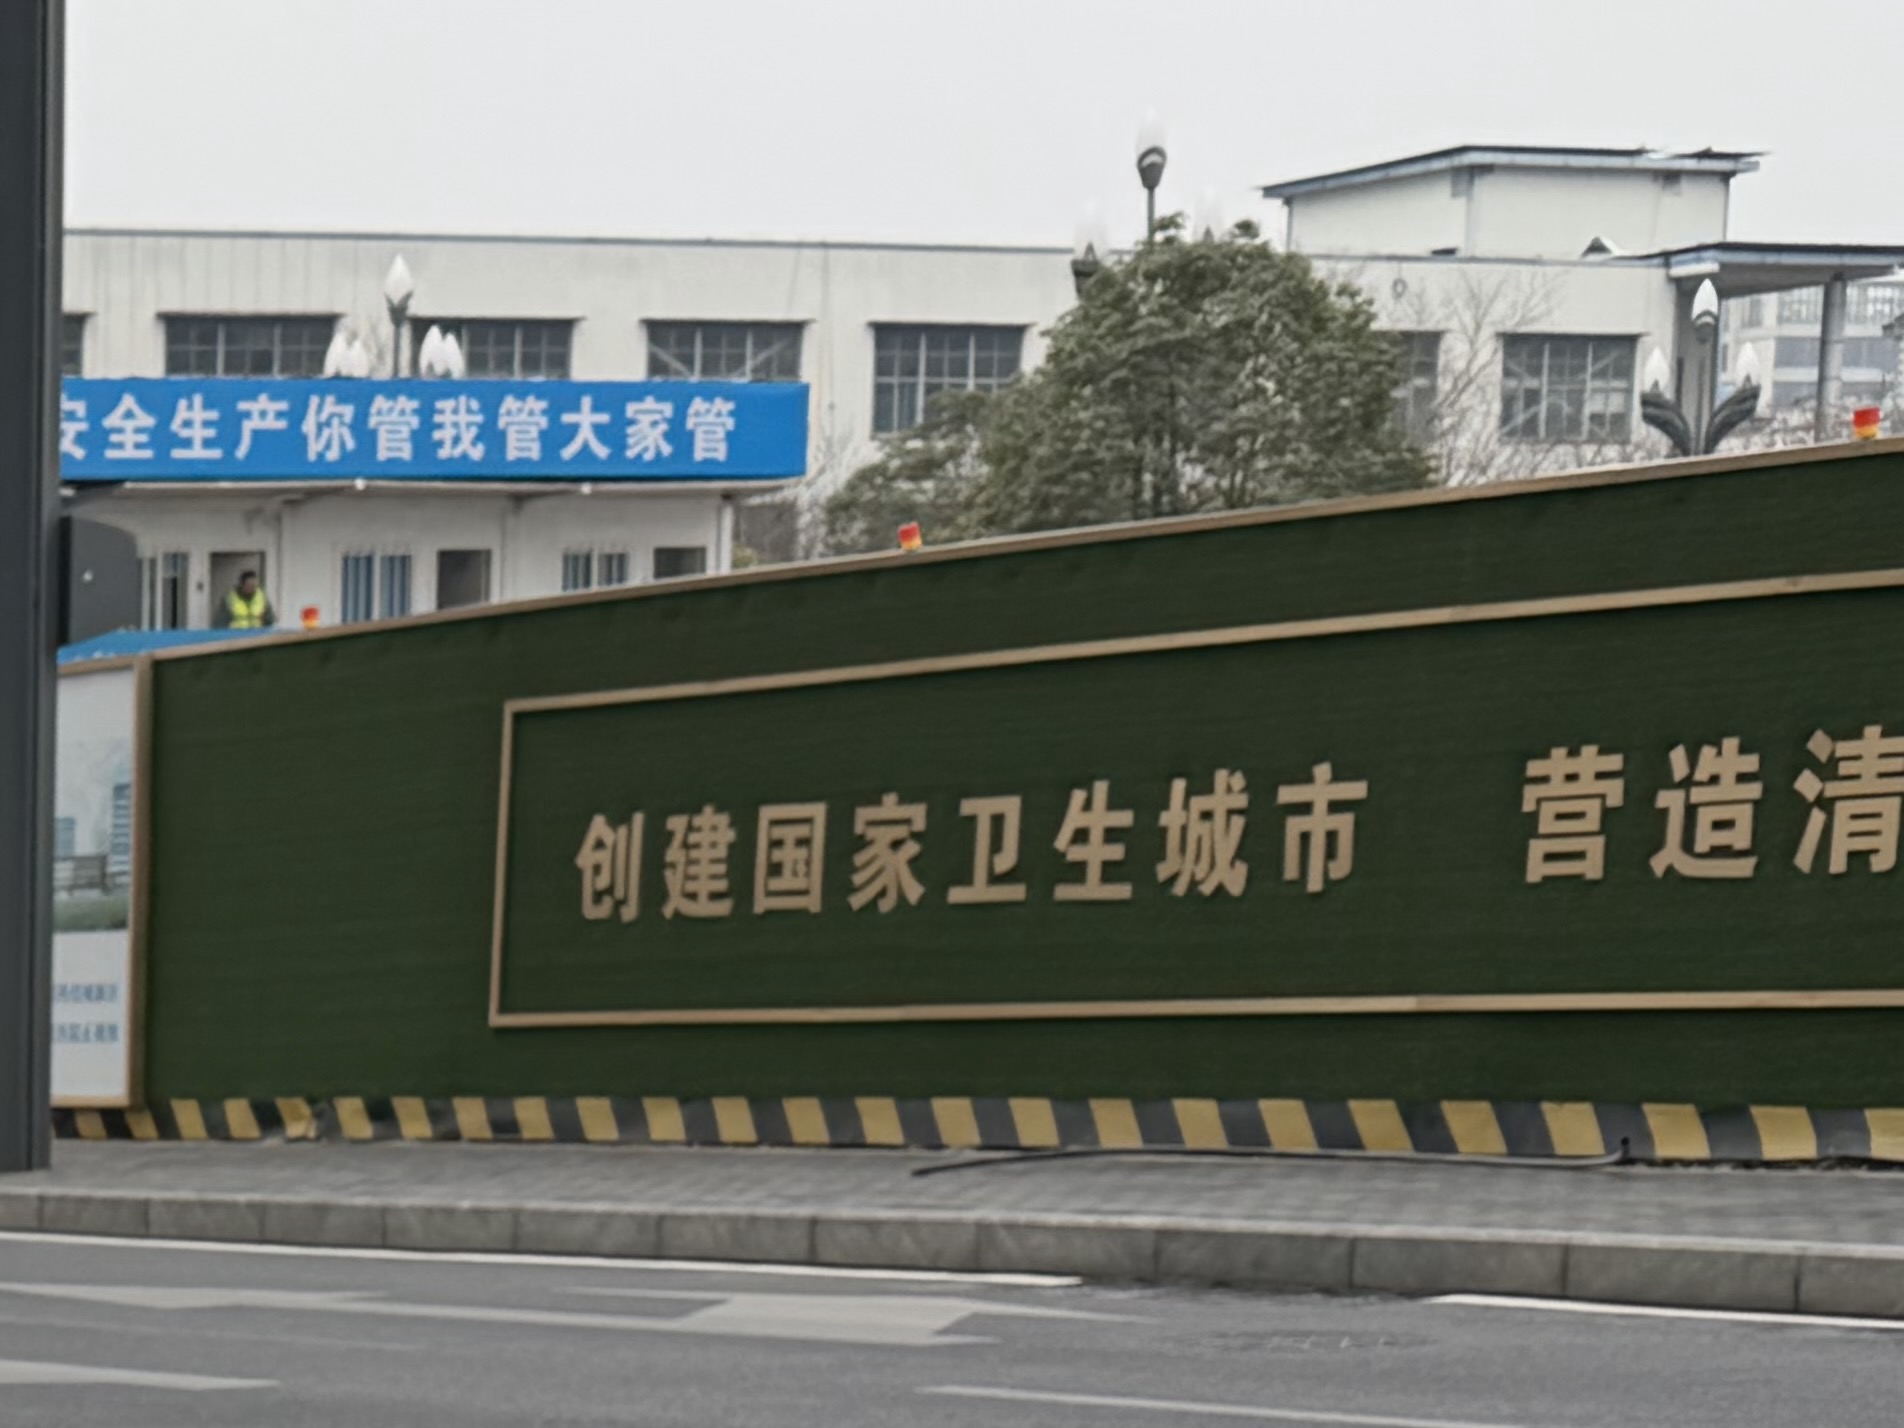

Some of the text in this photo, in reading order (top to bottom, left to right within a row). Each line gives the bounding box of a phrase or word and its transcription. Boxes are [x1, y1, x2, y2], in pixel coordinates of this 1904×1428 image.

[60, 393, 737, 463] 安全生产你管我管大家管
[575, 725, 1904, 923] 创建国家卫生城市 营造清
